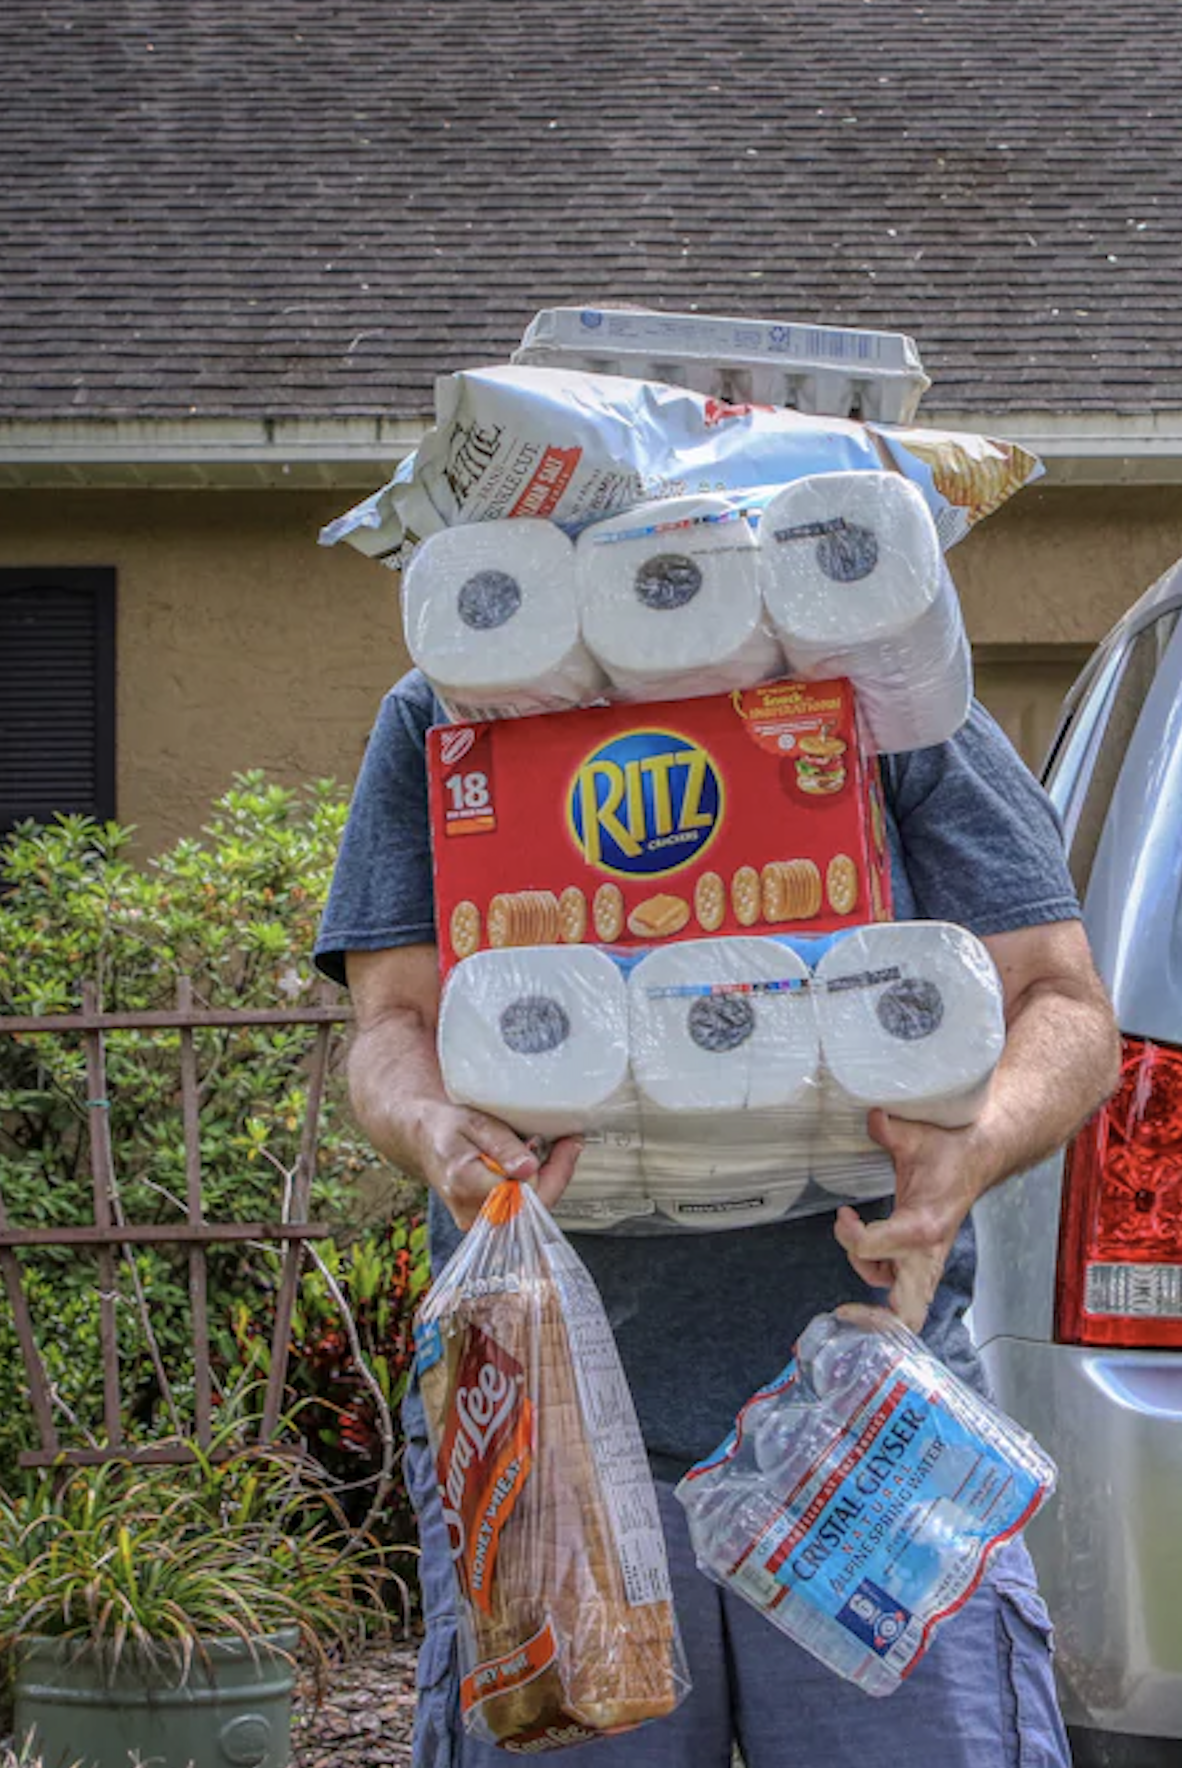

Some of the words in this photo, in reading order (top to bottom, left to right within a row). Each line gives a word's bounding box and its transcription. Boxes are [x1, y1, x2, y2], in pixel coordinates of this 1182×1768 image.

[445, 772, 489, 809] 18
[579, 750, 713, 864] RITZ
[455, 1362, 517, 1461] Lee
[791, 1497, 865, 1581] CRYSTAL
[855, 1407, 926, 1495] GEYSER
[842, 1464, 912, 1554] NATURAL
[870, 1491, 913, 1544] SPRING
[907, 1435, 946, 1489] WATER
[472, 1519, 496, 1590] HONEY
